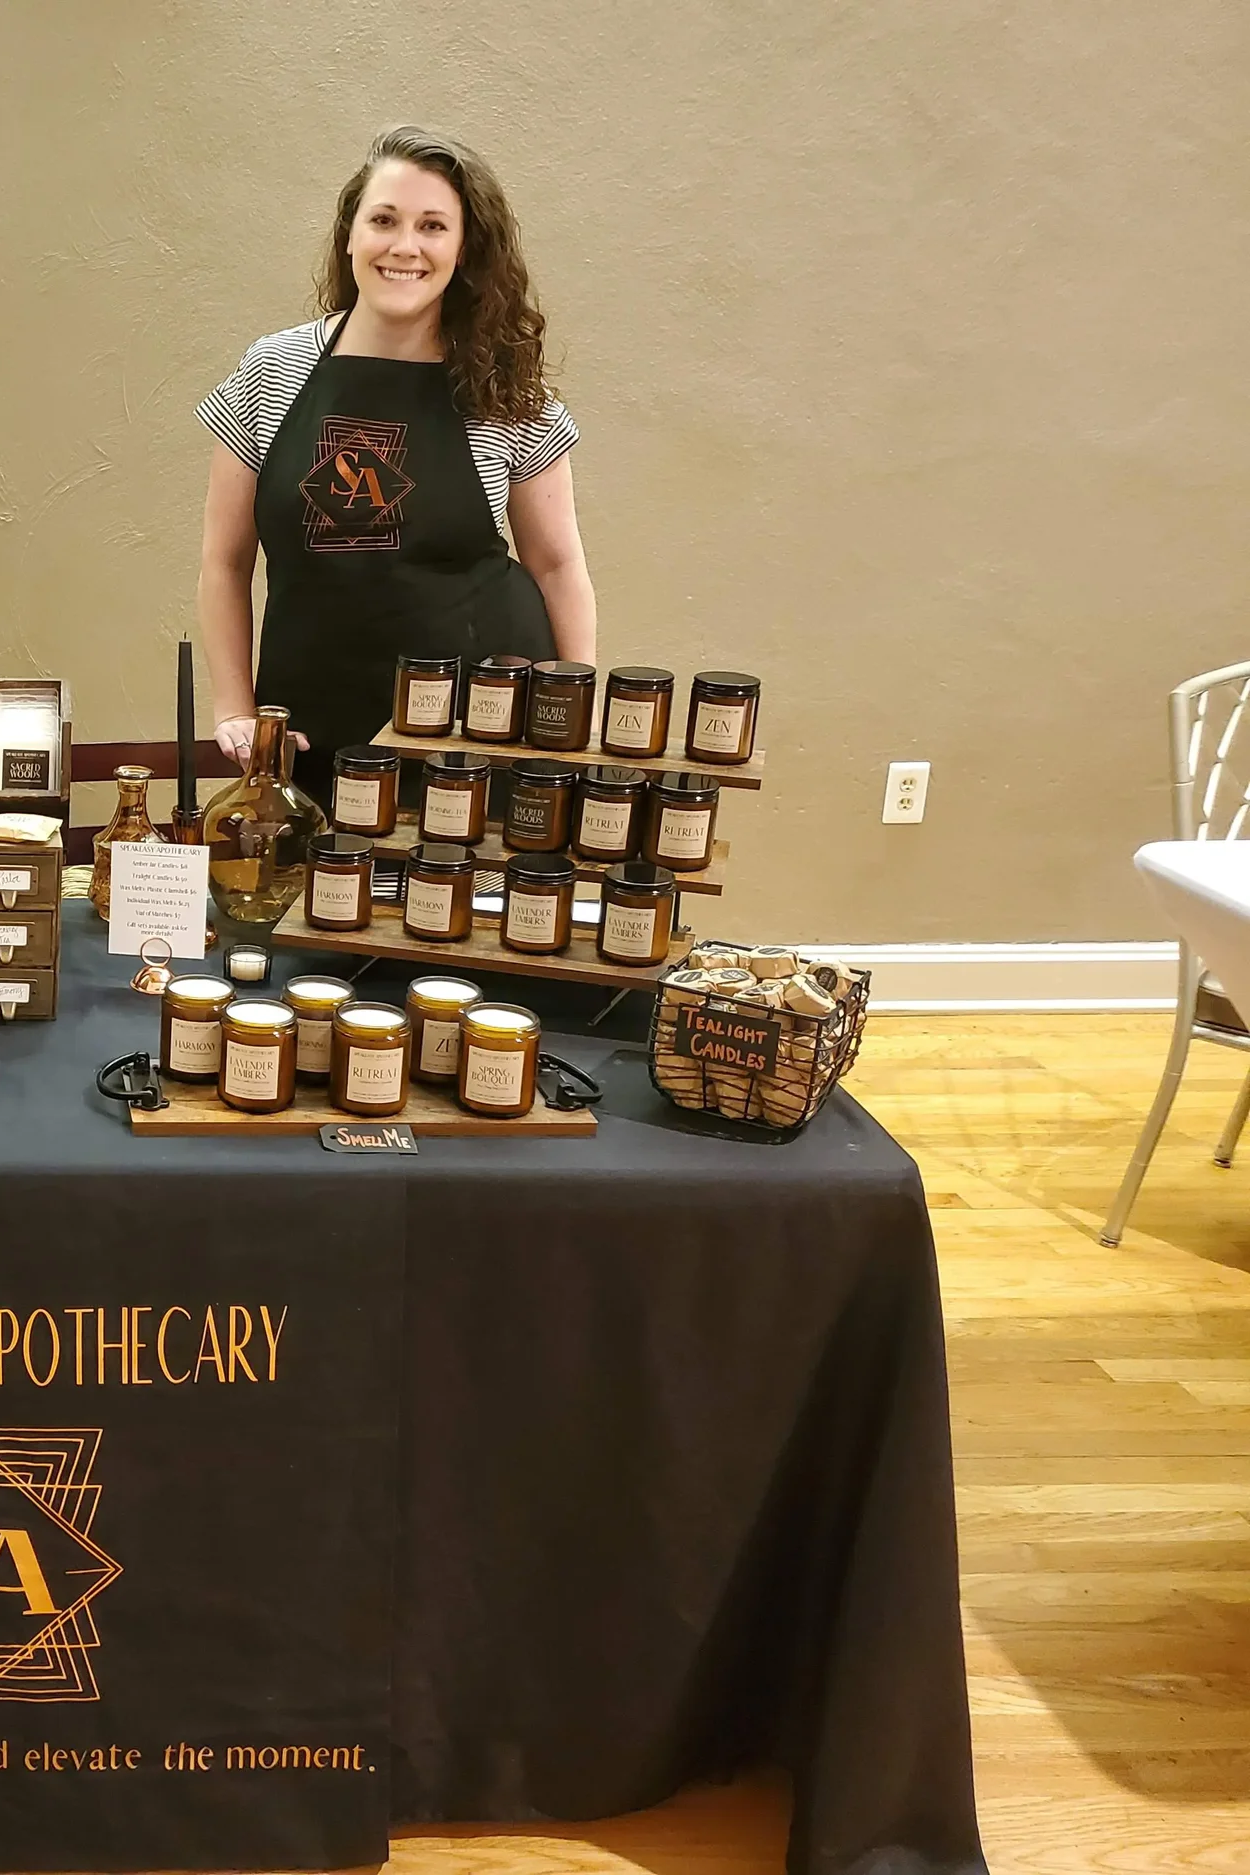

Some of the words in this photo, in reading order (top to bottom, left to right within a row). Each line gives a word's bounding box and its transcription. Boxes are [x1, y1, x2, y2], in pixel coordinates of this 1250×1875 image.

[330, 450, 388, 508] SA
[537, 704, 567, 714] SACRED
[537, 712, 566, 722] WOODS
[616, 714, 643, 730] ZEN
[704, 718, 732, 734] ZEN
[10, 762, 41, 772] SACRED
[10, 770, 41, 779] WOODS
[514, 805, 544, 817] SACRED
[513, 814, 544, 825] WOODS
[585, 816, 625, 830] RETREAT
[664, 825, 705, 838] RETREAT
[120, 845, 155, 853] SPEAKEASY
[156, 846, 202, 856] APOTHECARY
[316, 889, 354, 901] HARMONY
[511, 905, 552, 917] LAVENDER
[515, 915, 546, 926] EMBERS
[608, 918, 650, 931] LAVENDER
[611, 928, 643, 939] EMBERS
[681, 1006, 768, 1045] TEALIGHT
[174, 1039, 216, 1051] HARMONY
[690, 1033, 766, 1071] CANDLES
[229, 1056, 274, 1071] LAVENDER
[233, 1068, 268, 1080] EMBERS
[353, 1066, 398, 1080] RETREAT
[478, 1065, 510, 1077] SPRING
[471, 1072, 515, 1086] BOUQUET
[24, 1742, 141, 1773] elevate
[164, 1741, 213, 1772] the
[225, 1742, 377, 1773] moment.
